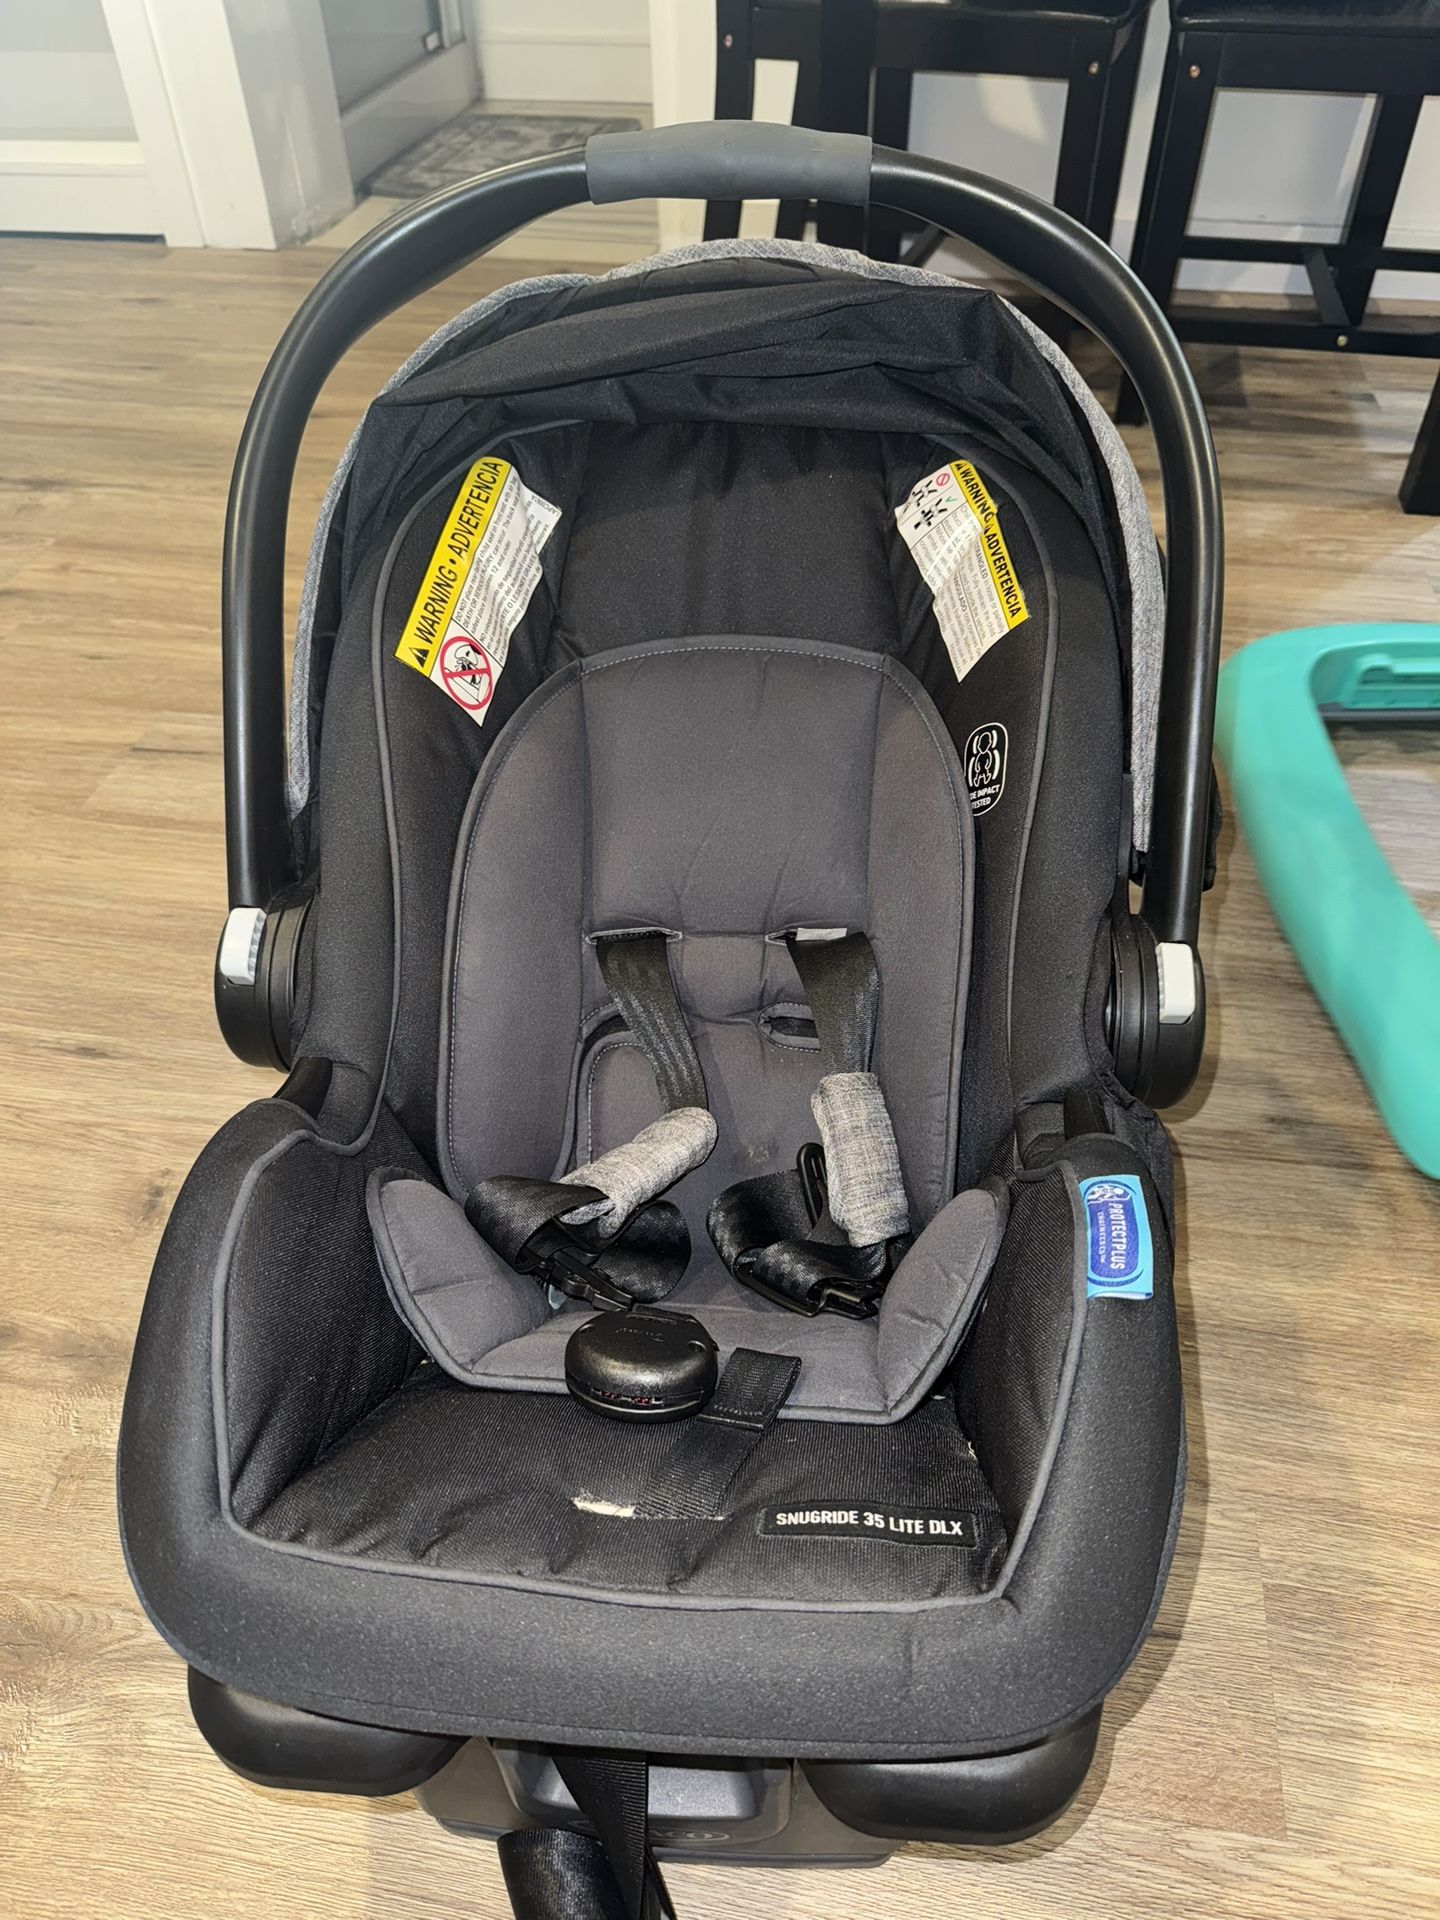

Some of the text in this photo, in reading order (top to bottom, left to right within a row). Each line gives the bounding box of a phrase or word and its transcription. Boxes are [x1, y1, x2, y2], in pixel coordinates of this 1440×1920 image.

[960, 468, 995, 522] WARNING
[413, 460, 503, 645] WARNING ADVERTENCIA
[984, 532, 1021, 617] ADVERTENCIA
[462, 607, 473, 628] DEATH
[1108, 1202, 1127, 1269] PROTECTPLUS
[776, 1510, 963, 1536] SNUGRIDE 35 LITE DLX
